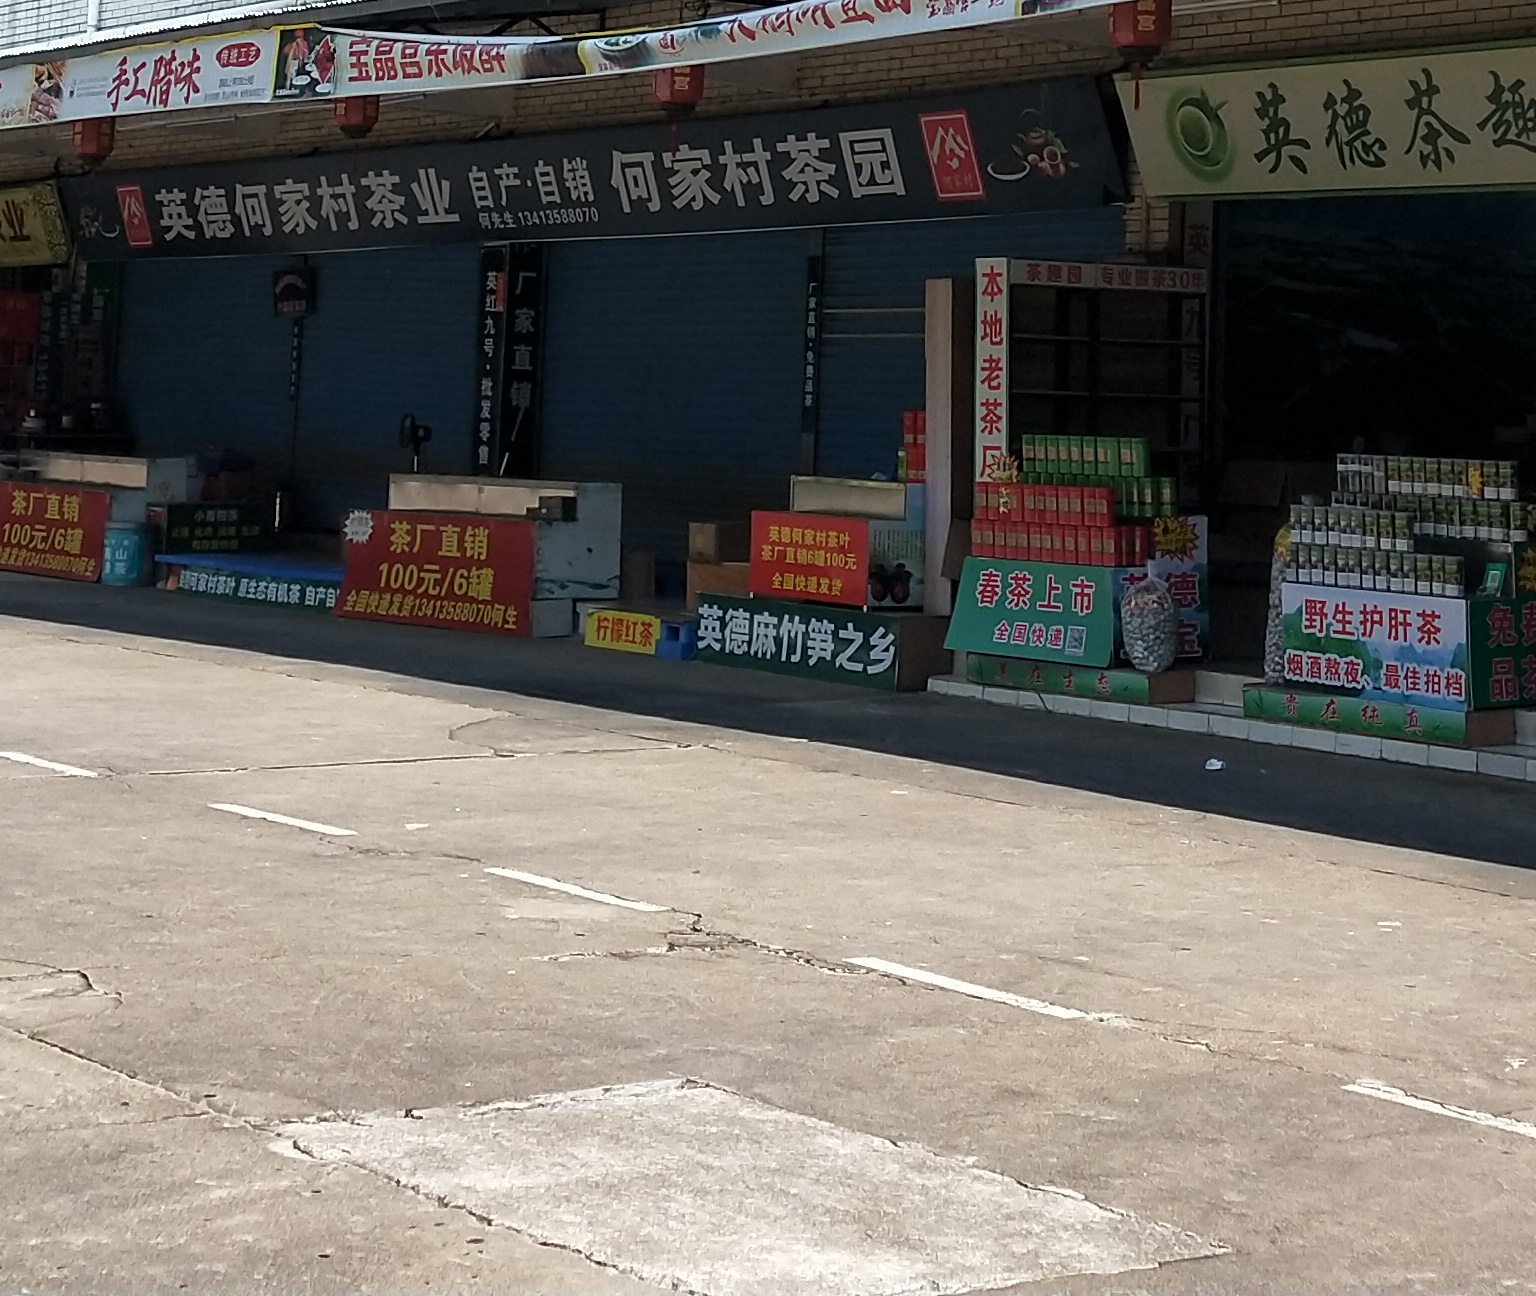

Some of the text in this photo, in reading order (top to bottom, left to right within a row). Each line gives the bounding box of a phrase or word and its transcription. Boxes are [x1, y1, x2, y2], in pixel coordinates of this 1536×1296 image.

[106, 47, 202, 113] 手工腊味
[609, 125, 908, 215] 何家村茶园
[153, 165, 462, 242] 英德何家村茶业
[517, 205, 600, 227] 13413588070
[1026, 262, 1084, 285] 茶趣园
[510, 271, 537, 409] 厂家直销
[979, 264, 1005, 479] 本地老茶厂
[10, 489, 80, 523] 茶厂直销
[388, 521, 490, 562] 茶厂直销
[768, 525, 851, 550] 英德何家村茶叶
[303, 583, 340, 610] 自产自
[377, 561, 496, 603] 100元/6罐
[770, 571, 843, 597] 全国快递发货
[976, 569, 1098, 616] 春茶上市
[595, 617, 659, 648] 柠檬红茶
[695, 602, 899, 677] 英德麻竹笋之乡
[993, 621, 1064, 650] 全国快递
[1302, 597, 1444, 648] 野生护肝茶
